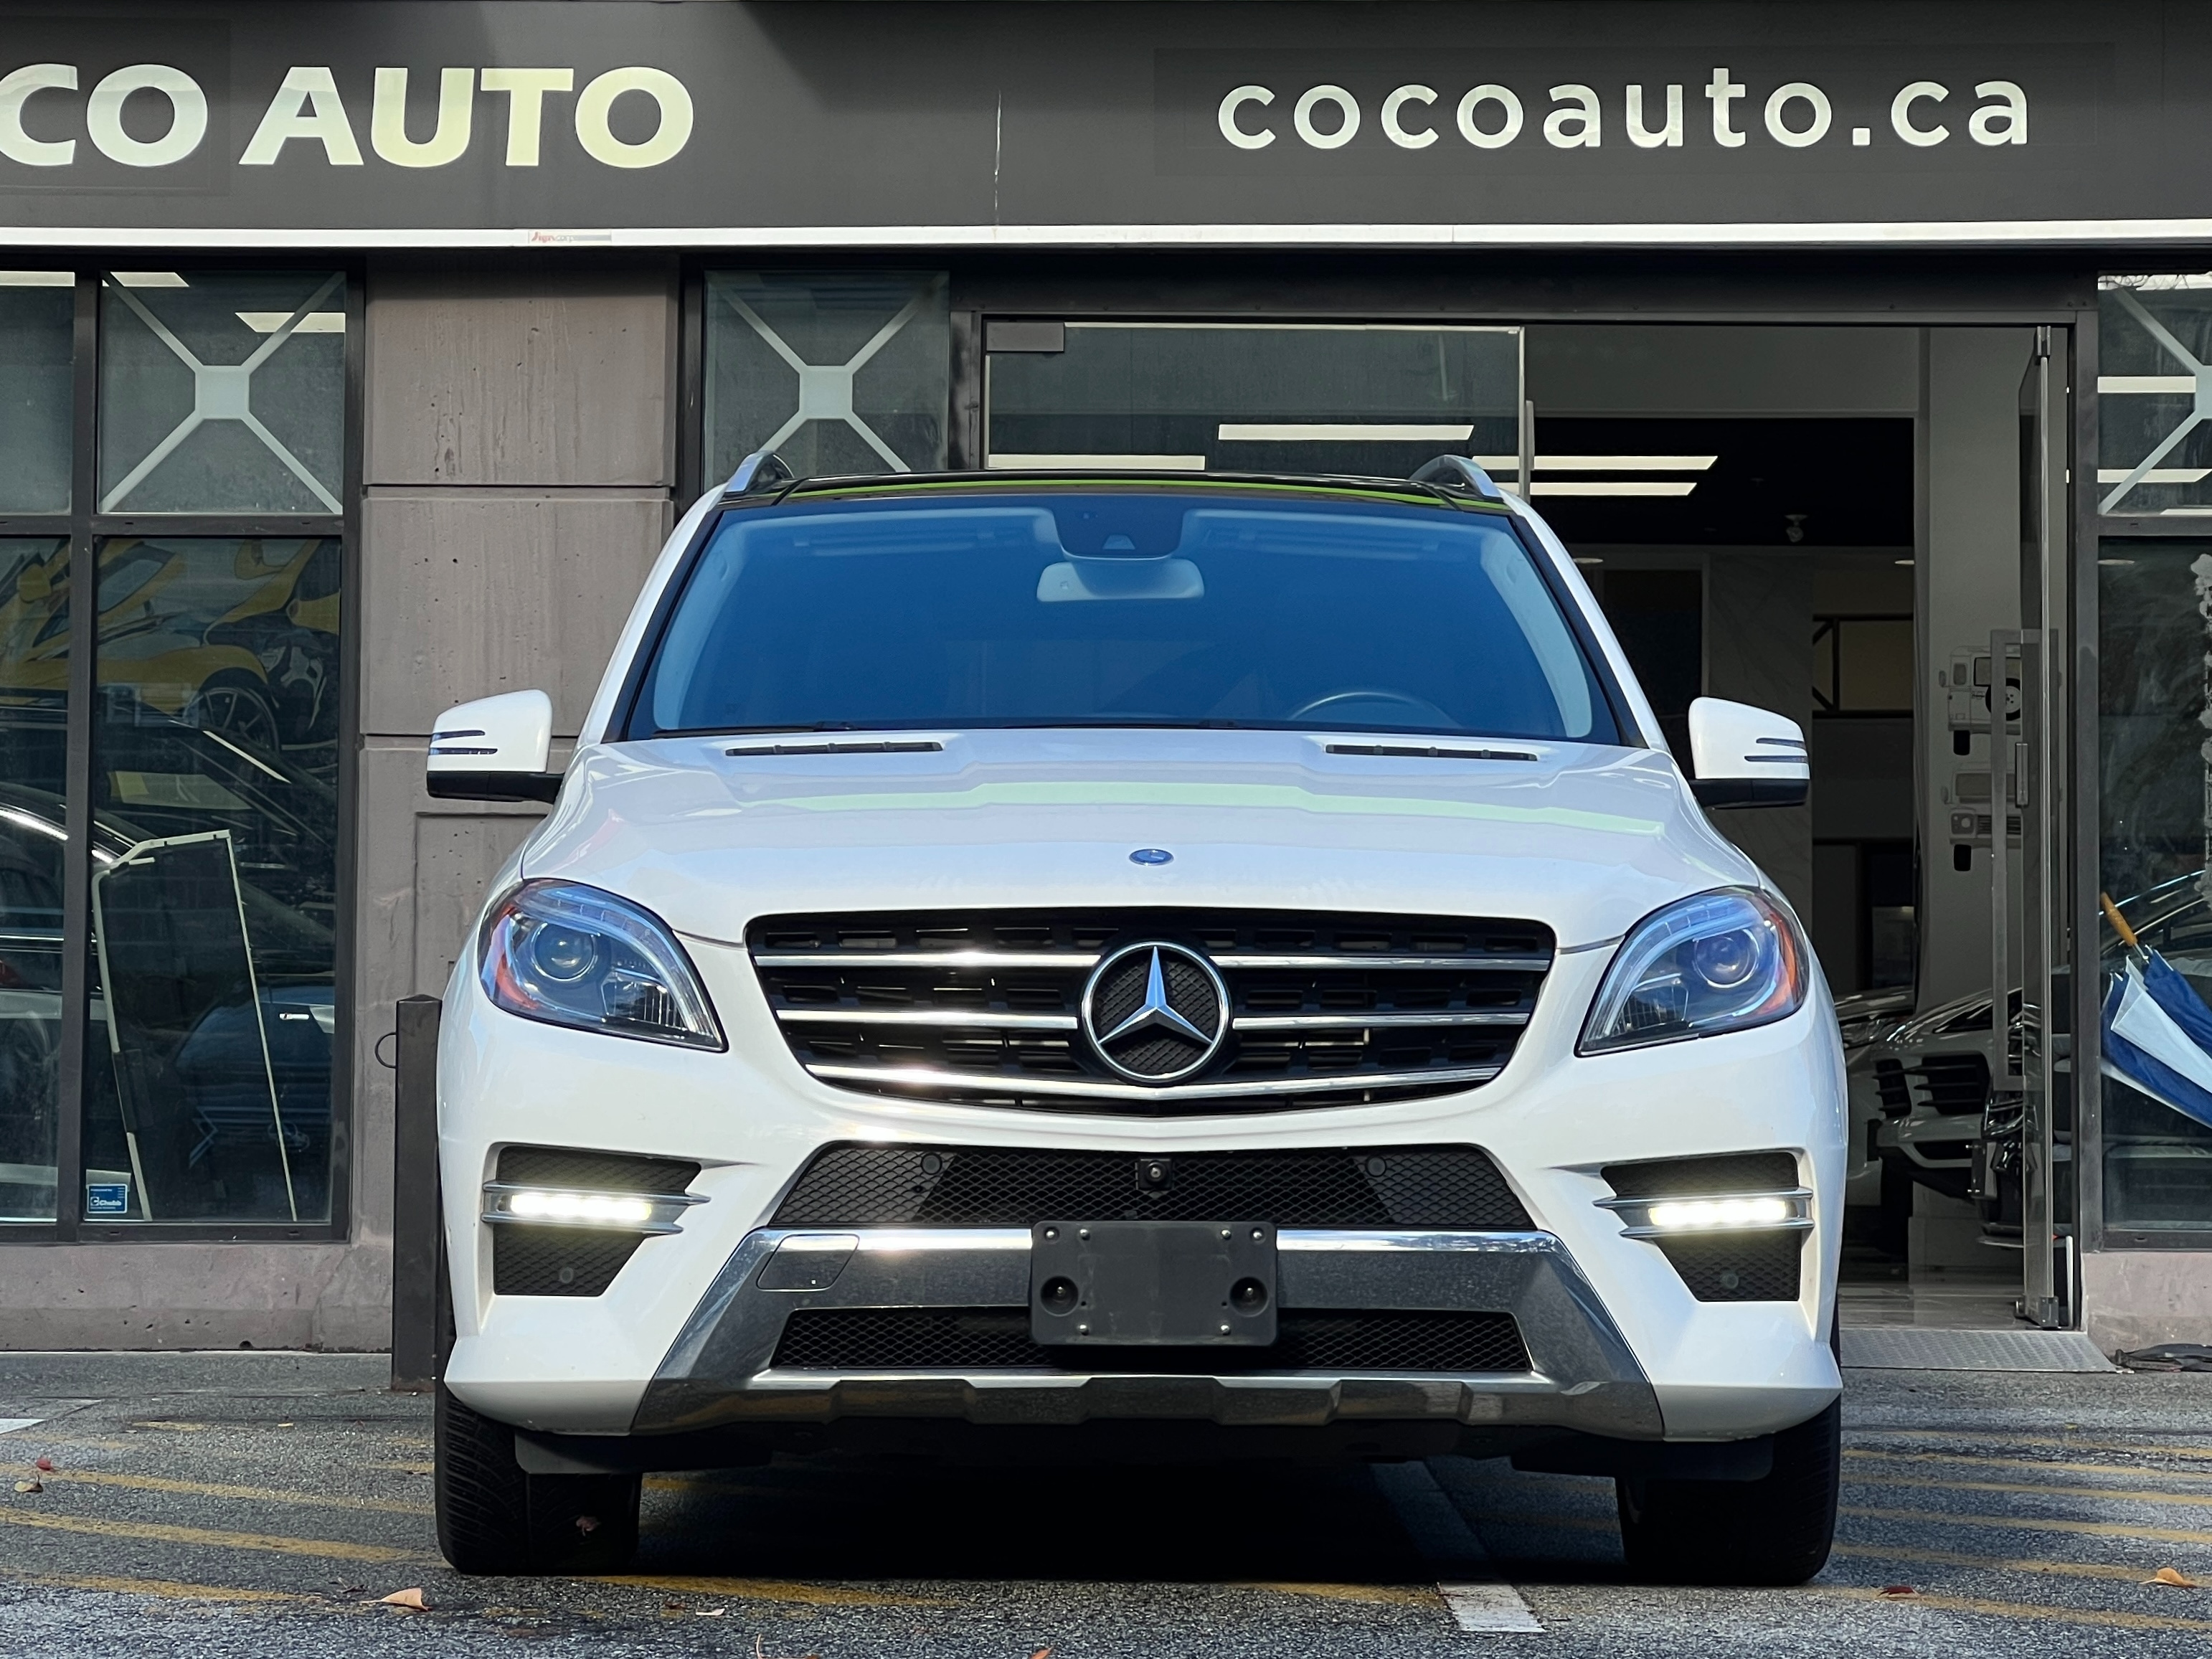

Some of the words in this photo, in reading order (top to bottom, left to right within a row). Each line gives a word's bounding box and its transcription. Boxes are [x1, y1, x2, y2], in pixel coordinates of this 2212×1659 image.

[0, 63, 209, 168] CO
[239, 66, 694, 169] AUTO
[1218, 67, 2028, 150] cocoauto.ca
